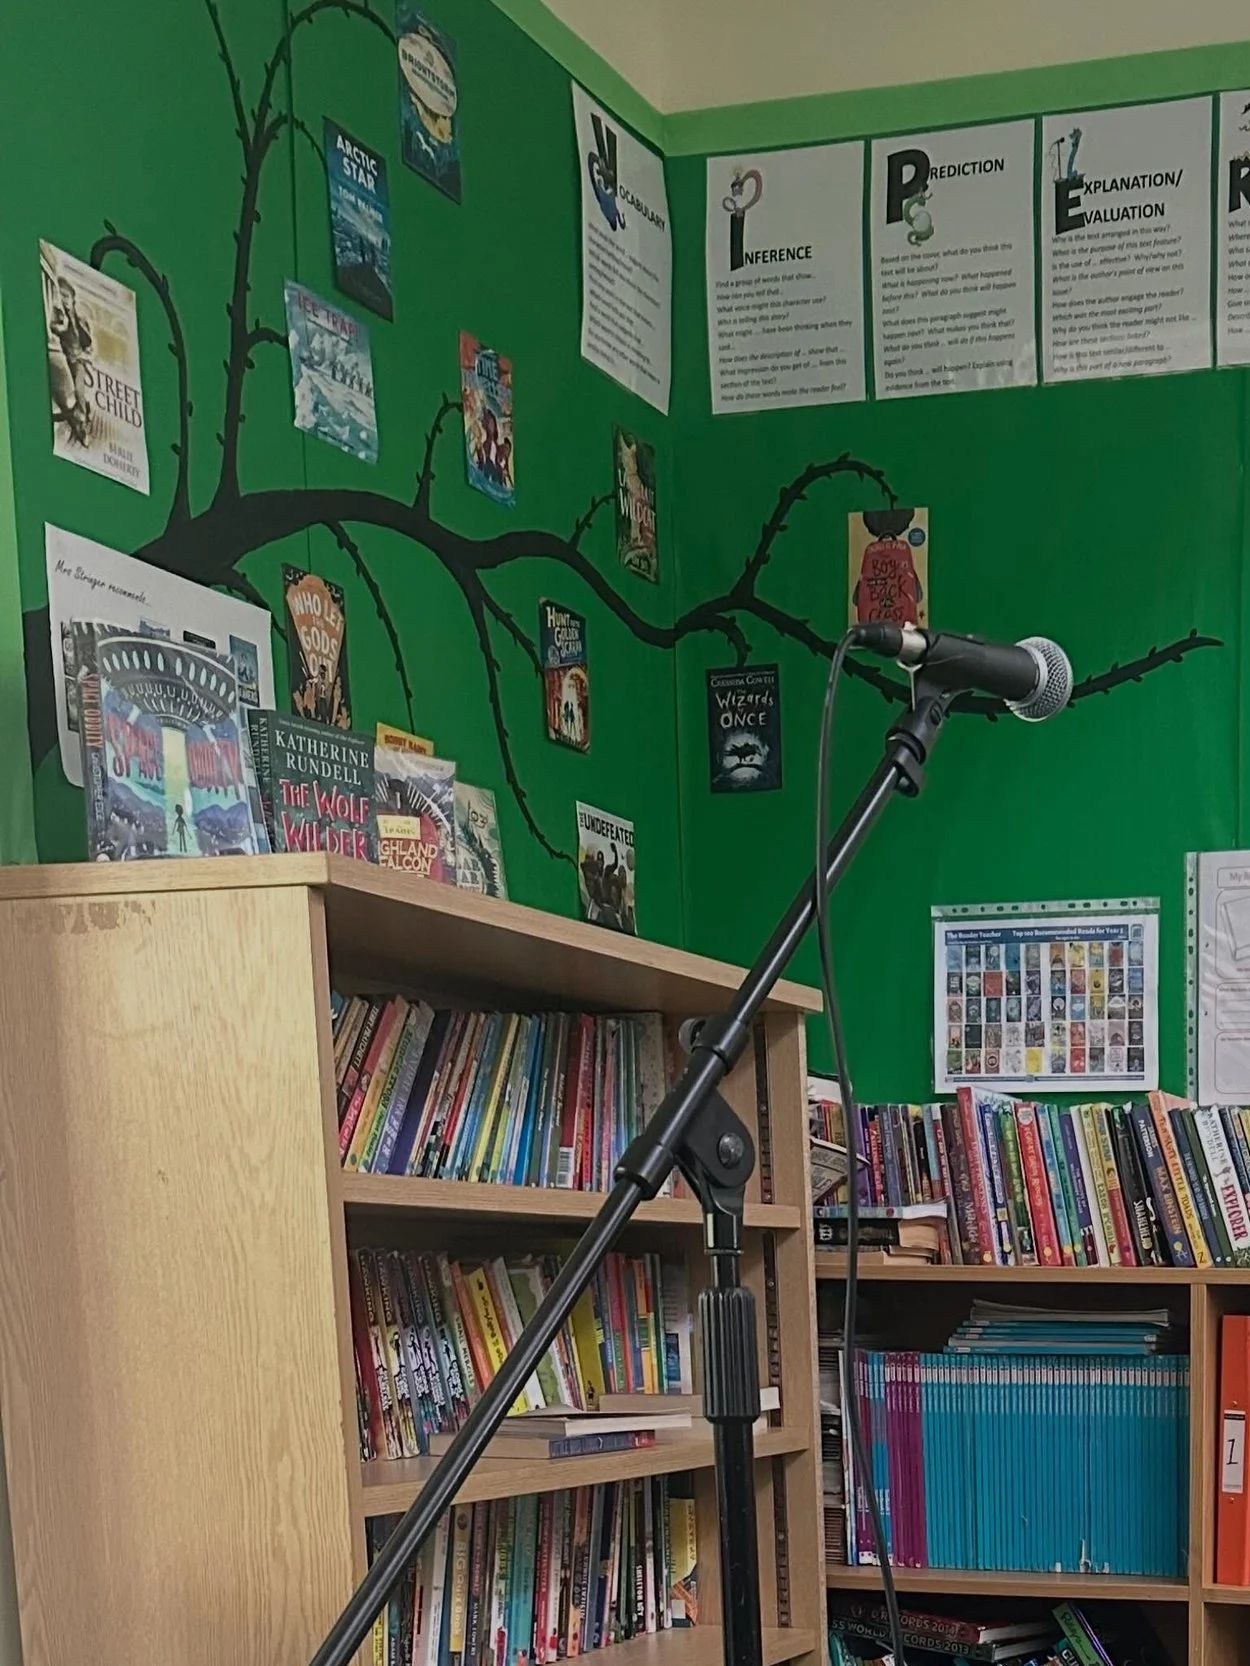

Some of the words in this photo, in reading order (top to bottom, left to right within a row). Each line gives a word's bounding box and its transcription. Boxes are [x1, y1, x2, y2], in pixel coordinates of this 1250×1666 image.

[336, 134, 378, 176] ARCTIC
[342, 156, 377, 194] STAR
[885, 148, 1005, 225] PREDICTION
[729, 211, 813, 272] INFERENCE
[83, 360, 140, 409] STREET
[95, 390, 142, 428] CHILD
[55, 559, 72, 577] Mrs
[294, 591, 321, 617] WHO
[323, 599, 341, 632] LET
[546, 606, 570, 628] HUNT
[301, 625, 338, 660] GODS
[715, 690, 774, 708] Wizards
[720, 711, 767, 729] ONCE
[274, 729, 370, 769] KATHERINE
[286, 752, 362, 786] RUNDELL
[279, 778, 310, 809] THE
[312, 779, 370, 824] WOLF
[280, 810, 369, 862] WILDER
[584, 813, 634, 847] UNDEFEATED
[378, 840, 438, 859] IGHLAND
[379, 855, 433, 876] FALCON
[1137, 1119, 1154, 1158] PATTERSON
[1221, 1183, 1249, 1241] EXPLORER
[1226, 1437, 1239, 1466] 1
